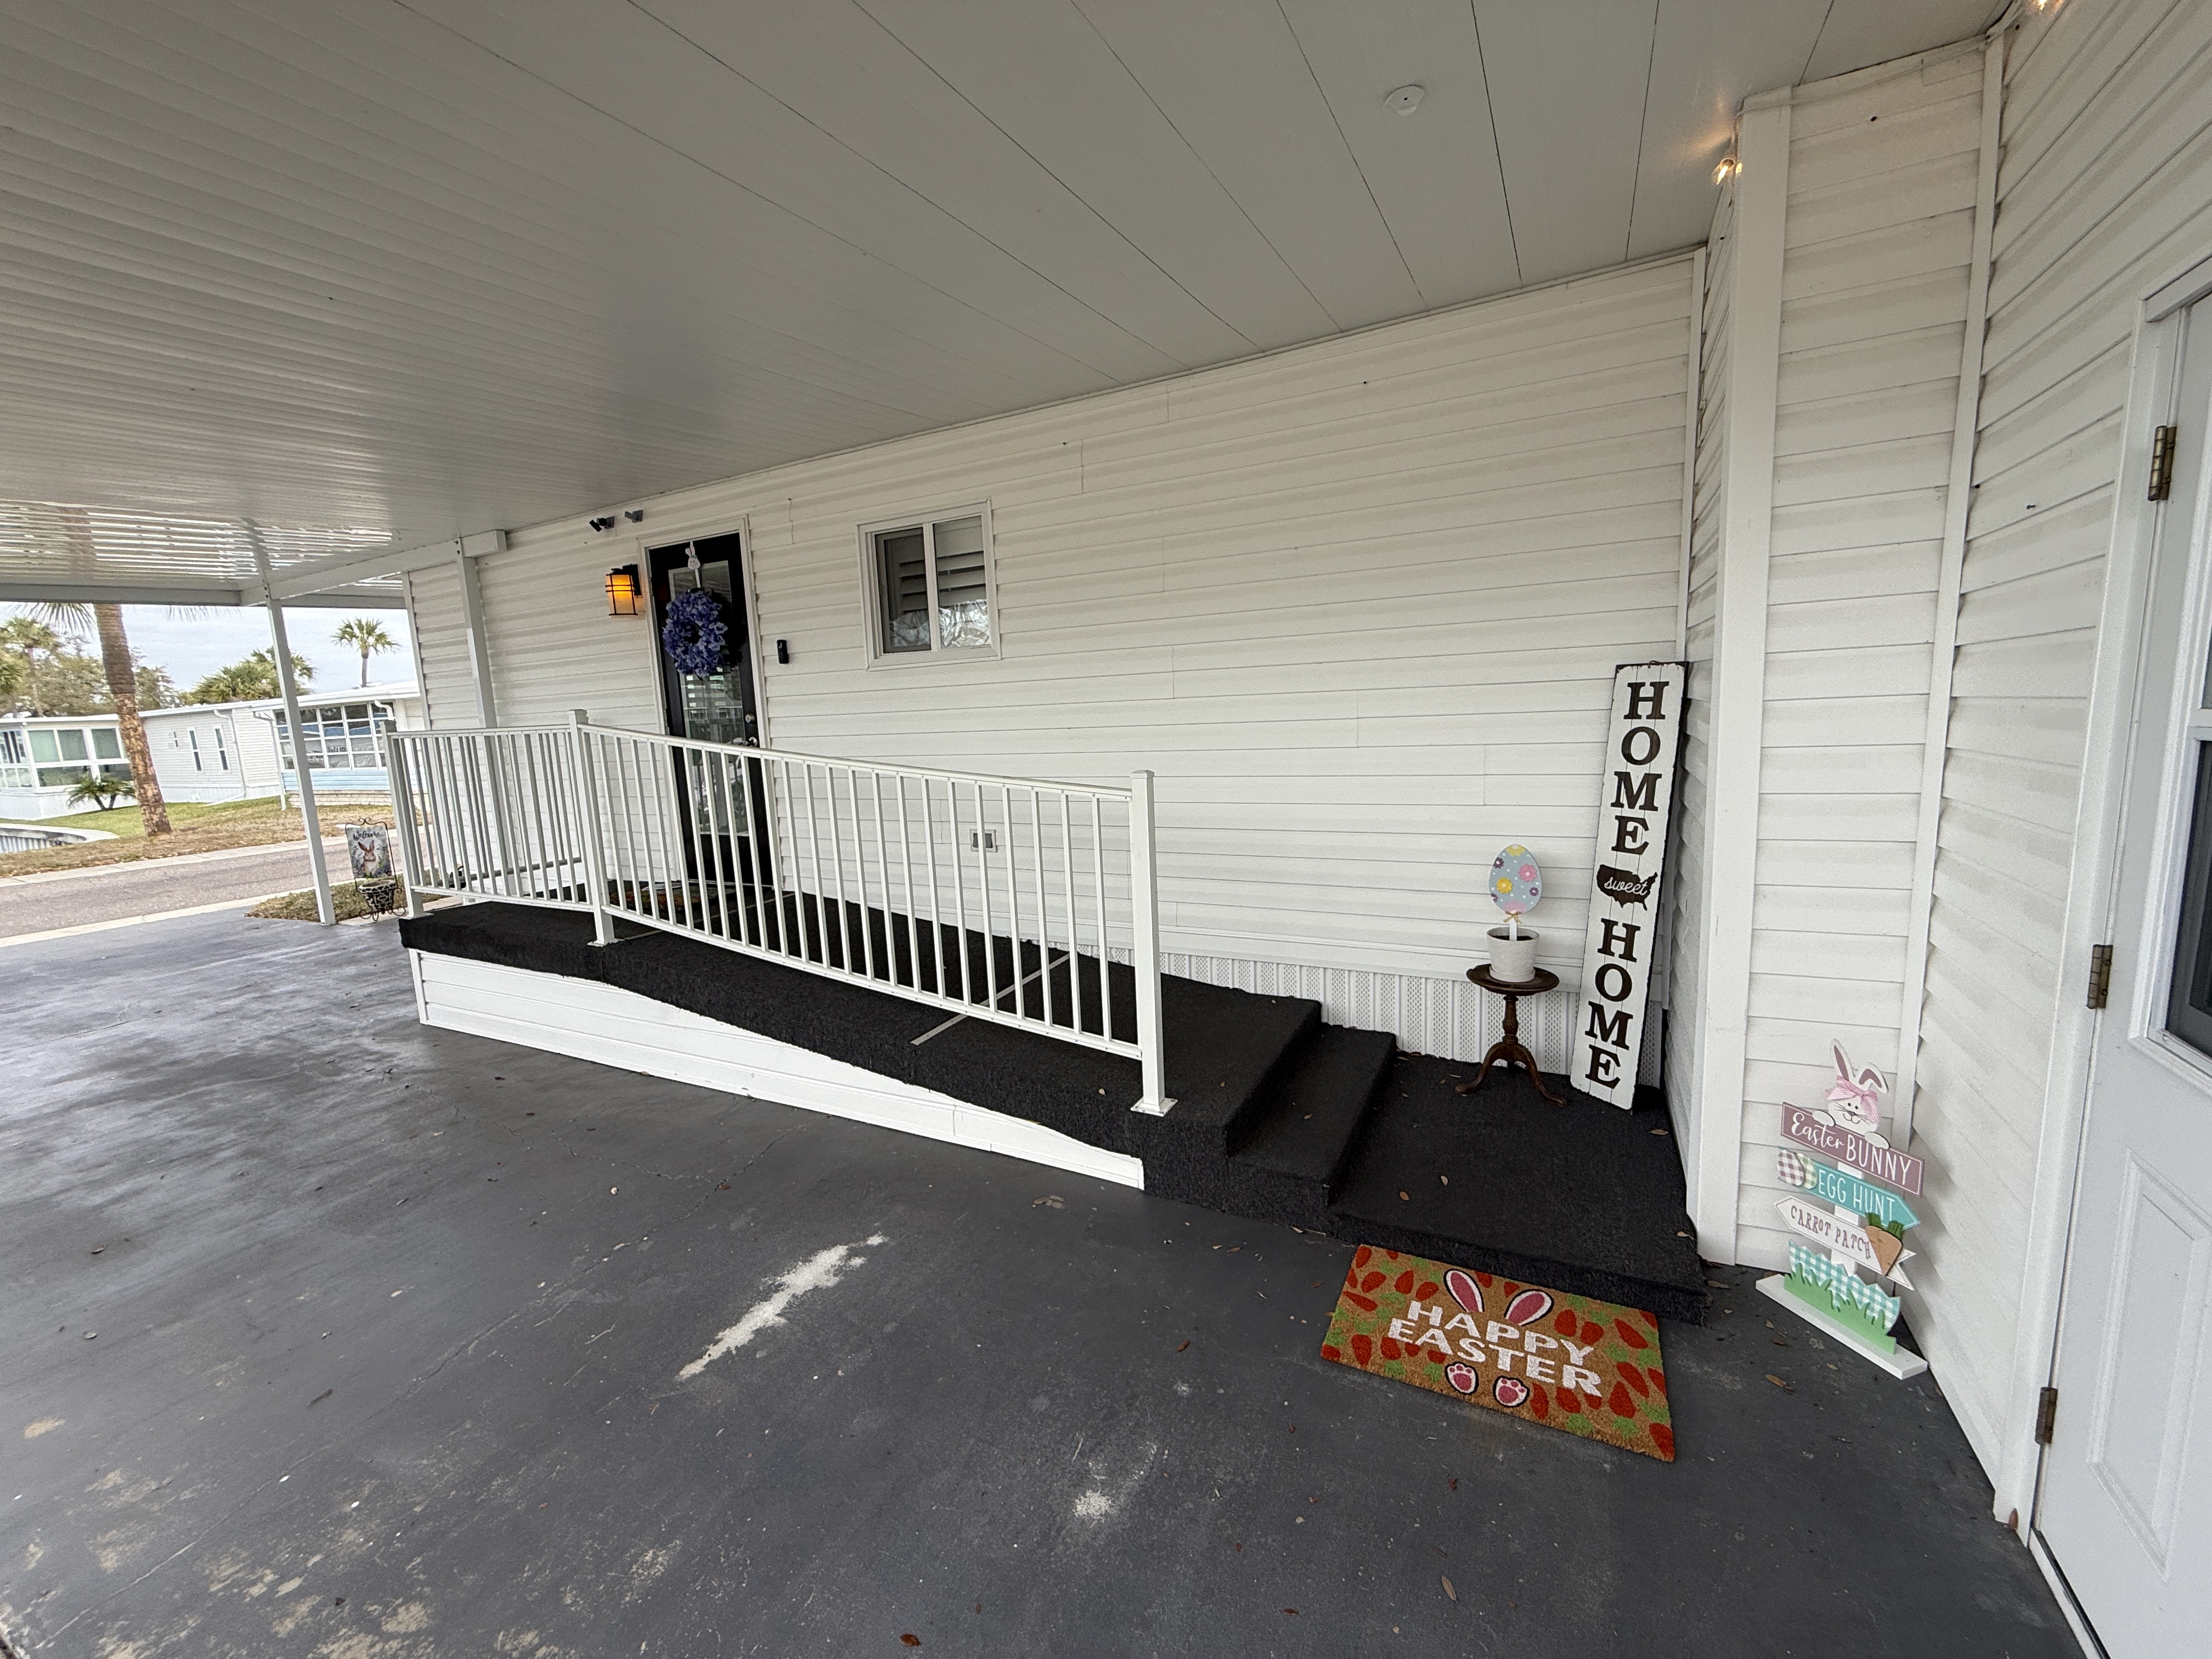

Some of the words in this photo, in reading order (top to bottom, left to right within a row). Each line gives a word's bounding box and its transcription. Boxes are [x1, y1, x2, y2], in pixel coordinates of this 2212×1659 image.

[1611, 681, 1669, 855] HOME
[1604, 876, 1648, 896] sweet
[1585, 918, 1641, 1089] HOME
[1791, 1112, 1845, 1149] Easter
[1846, 1134, 1911, 1185] BUNNY
[1818, 1169, 1846, 1203] EGG
[1853, 1183, 1895, 1222] HUNT
[1791, 1205, 1831, 1237] CARROT
[1835, 1226, 1871, 1260] PATCH
[1387, 1318, 1602, 1397] EASTER
[1407, 1300, 1594, 1366] HAPPY
